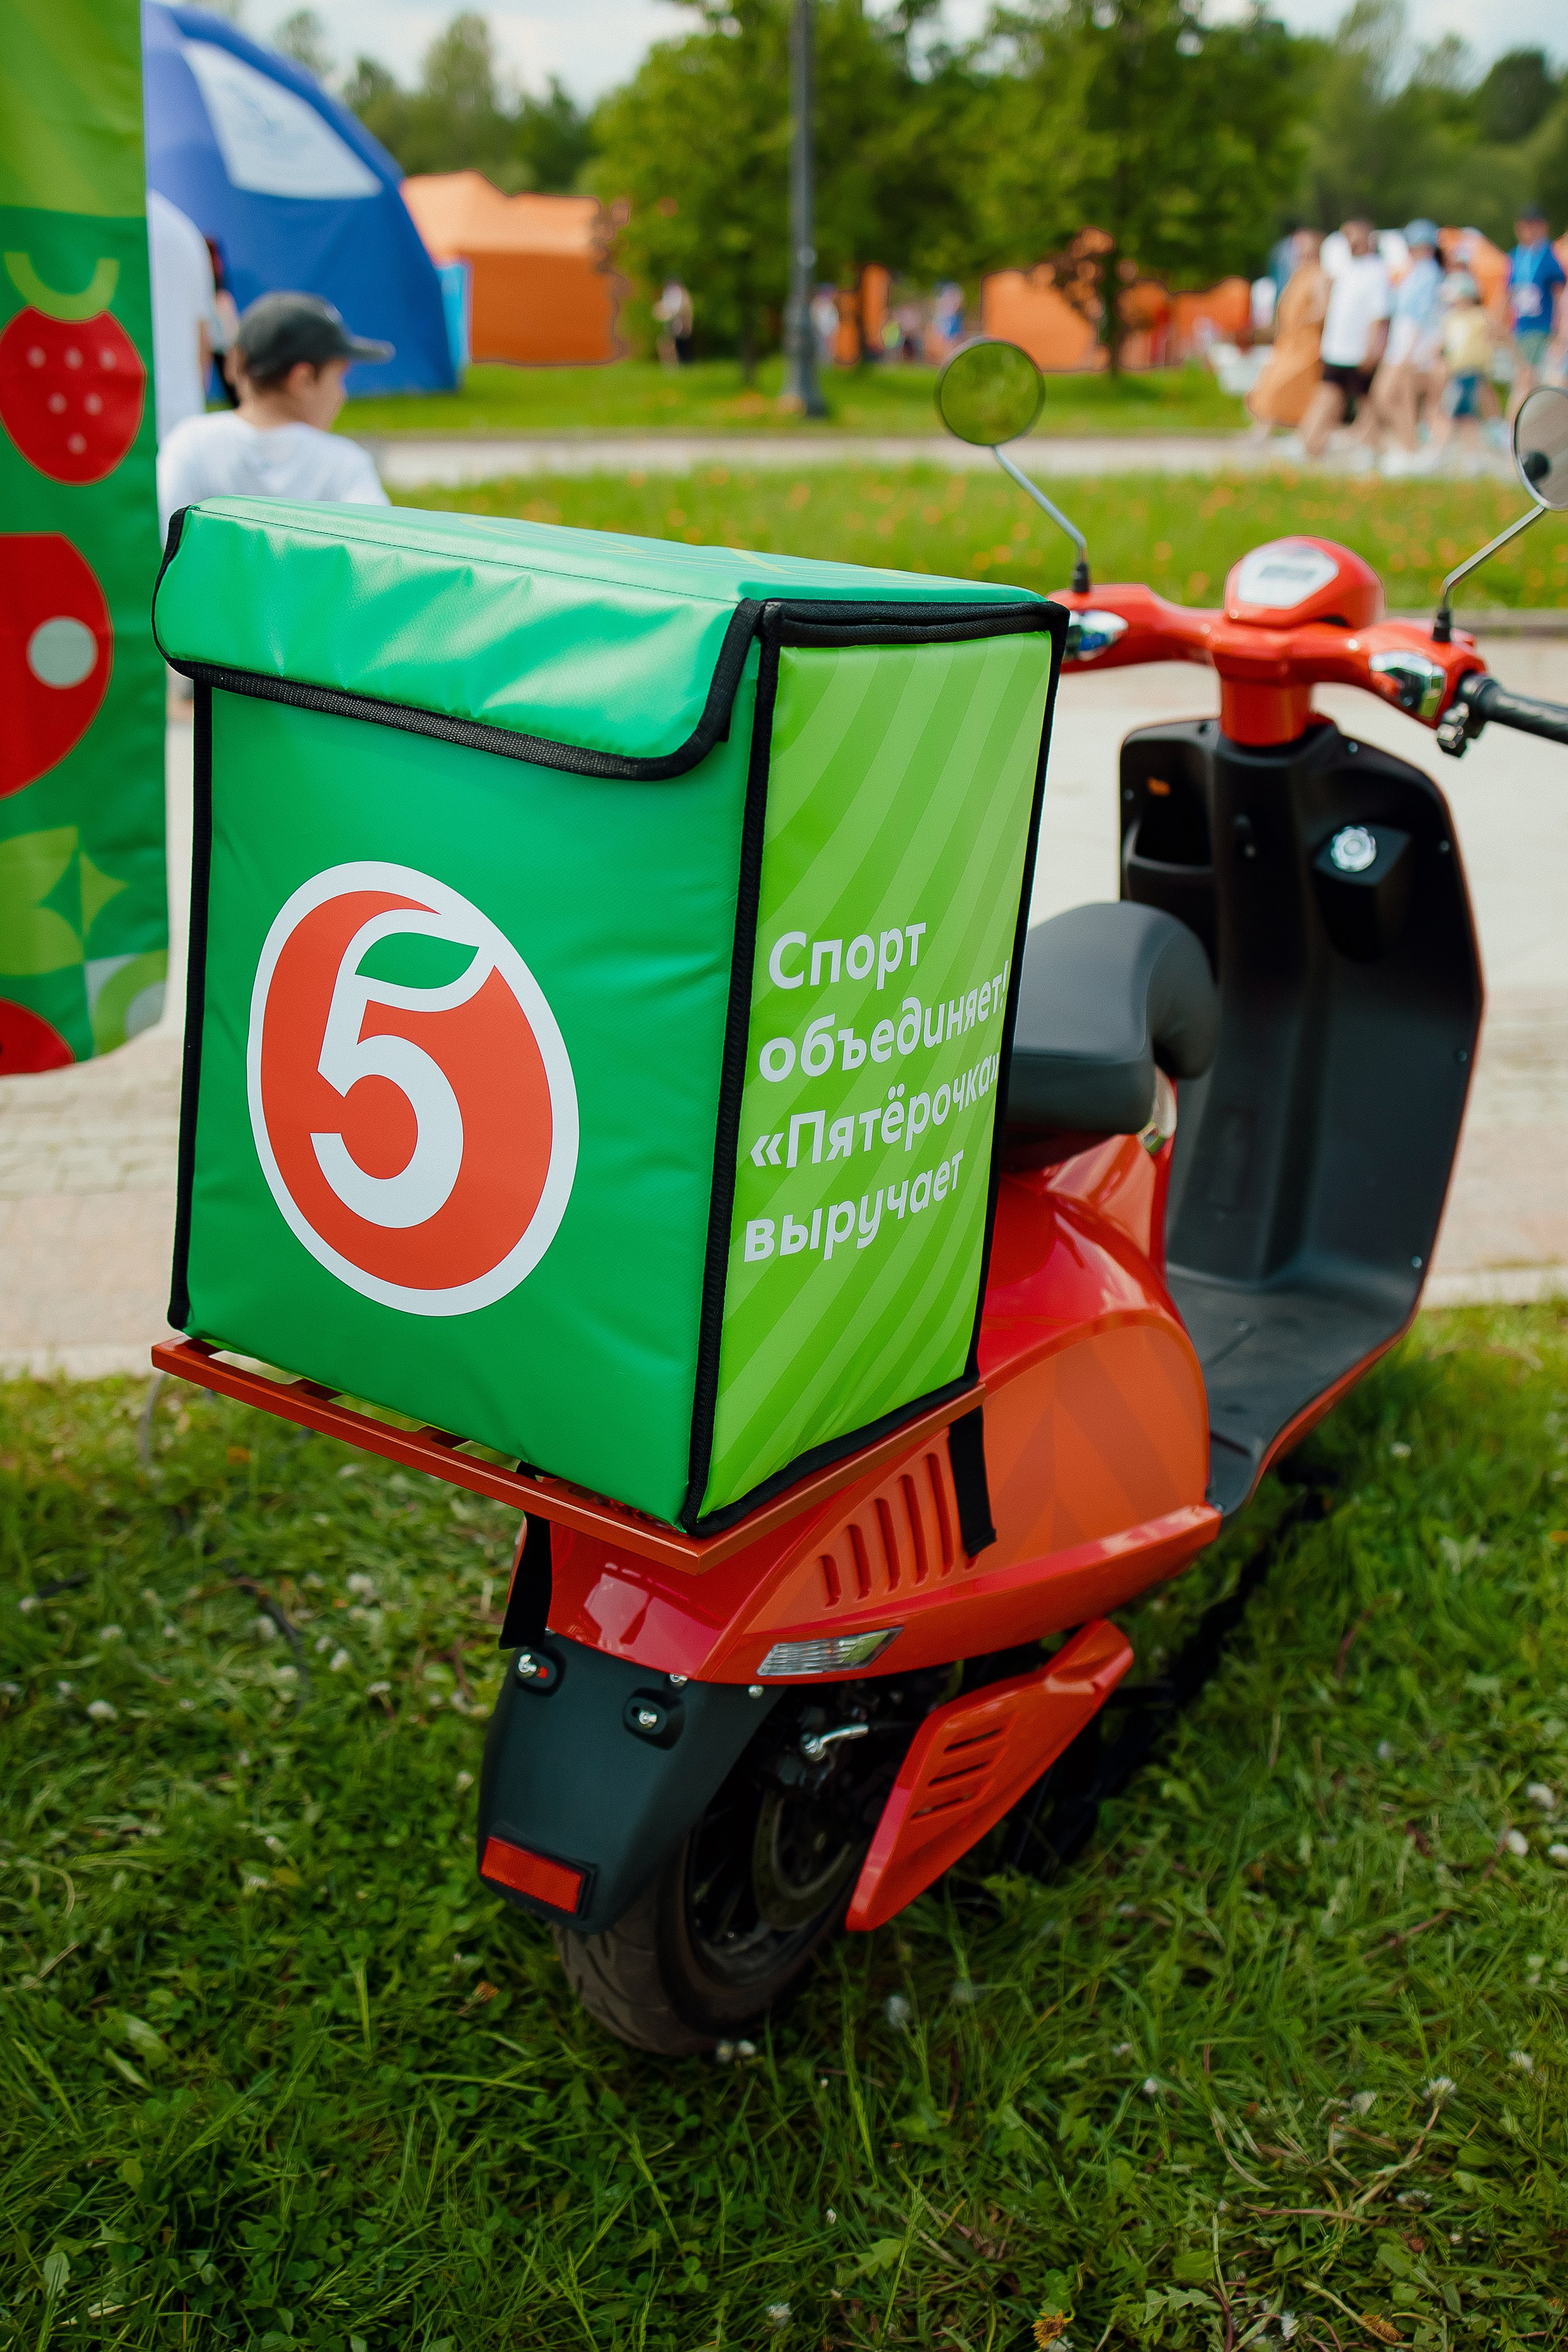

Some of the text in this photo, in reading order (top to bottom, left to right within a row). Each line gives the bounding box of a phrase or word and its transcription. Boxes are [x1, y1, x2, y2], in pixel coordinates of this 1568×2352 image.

[768, 922, 927, 990] Спорт
[309, 908, 484, 1229] 5
[758, 959, 1009, 1083] объединяет!
[743, 1149, 964, 1262] выручает
